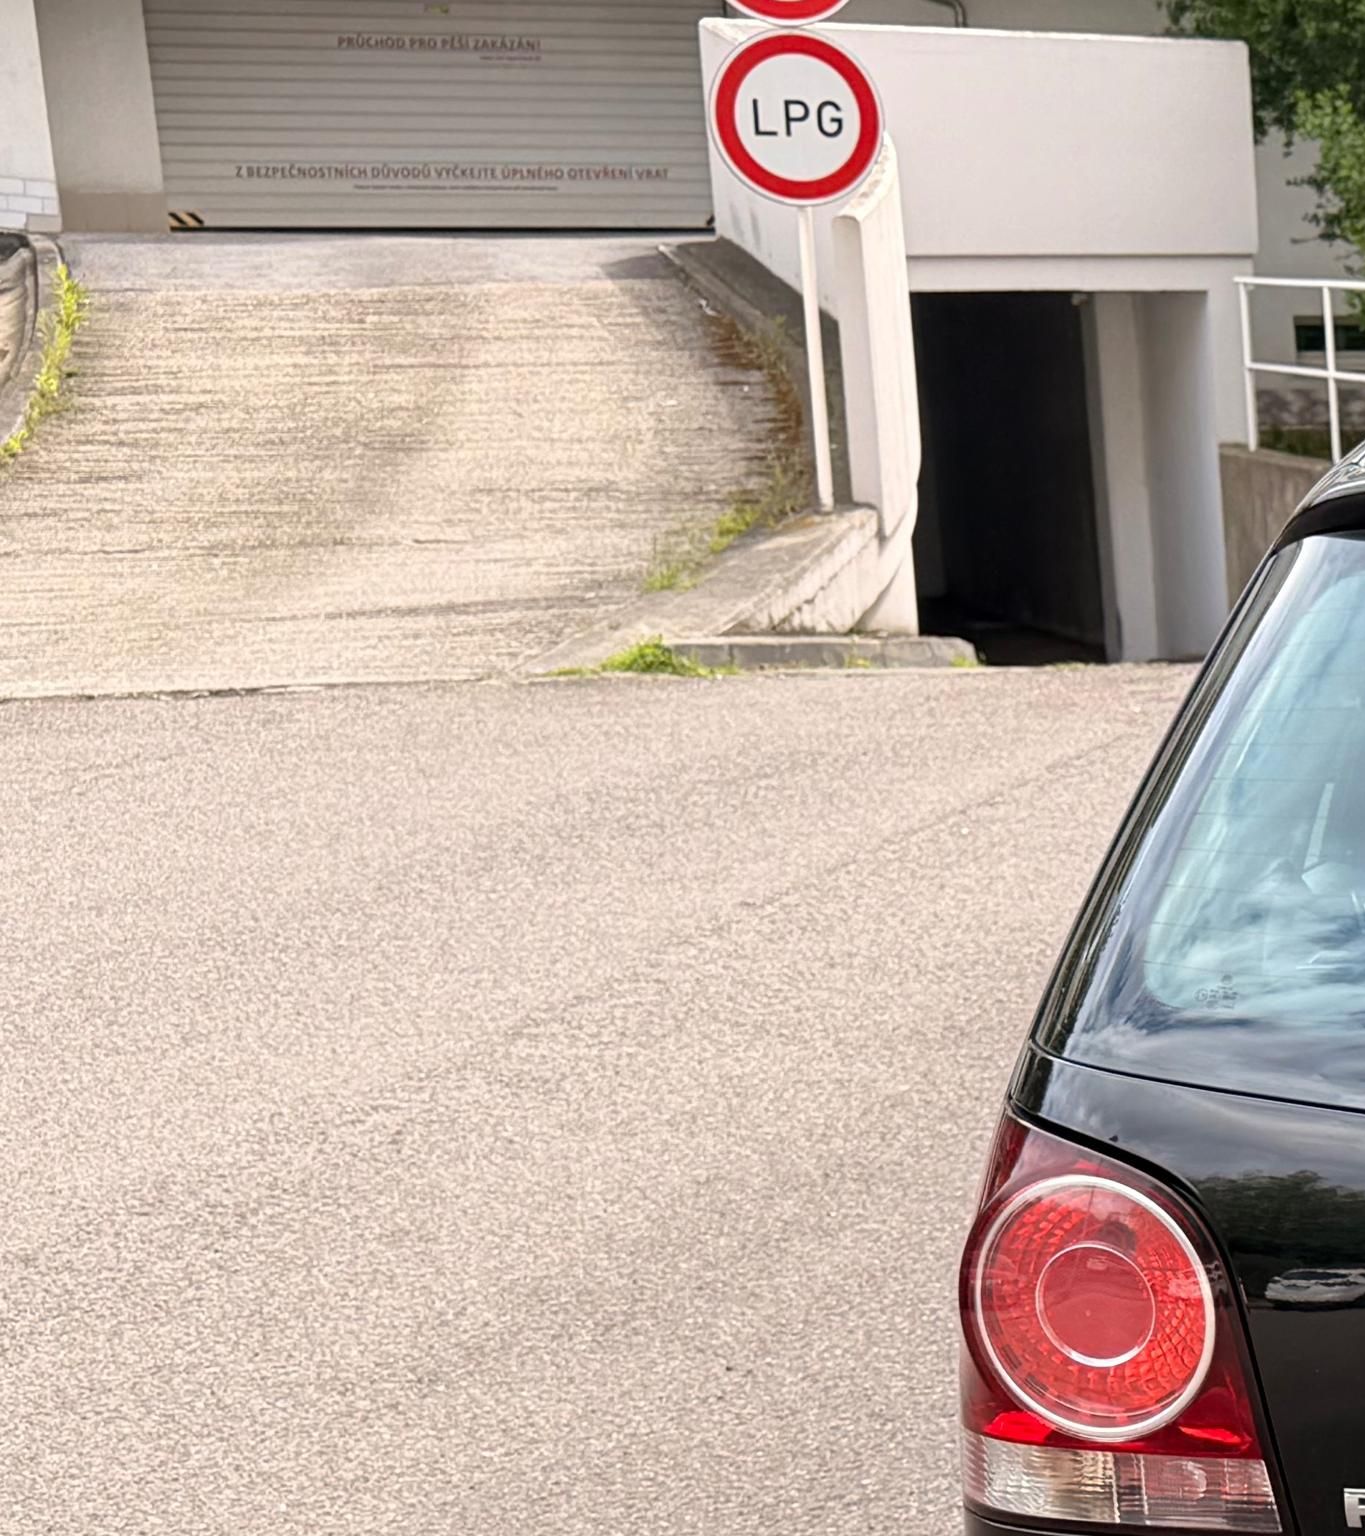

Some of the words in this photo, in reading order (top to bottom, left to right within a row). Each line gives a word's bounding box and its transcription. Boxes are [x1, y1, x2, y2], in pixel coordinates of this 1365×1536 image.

[337, 33, 405, 50] PRŮCHOD
[409, 36, 438, 50] PRO
[752, 98, 843, 138] LPG
[235, 165, 243, 179] Z
[246, 163, 368, 179] BEZPEČNOSTNÍCH
[371, 163, 432, 179] DŮVODŮ
[434, 164, 497, 180] VYČKEJTE
[635, 167, 670, 180] VRAT
